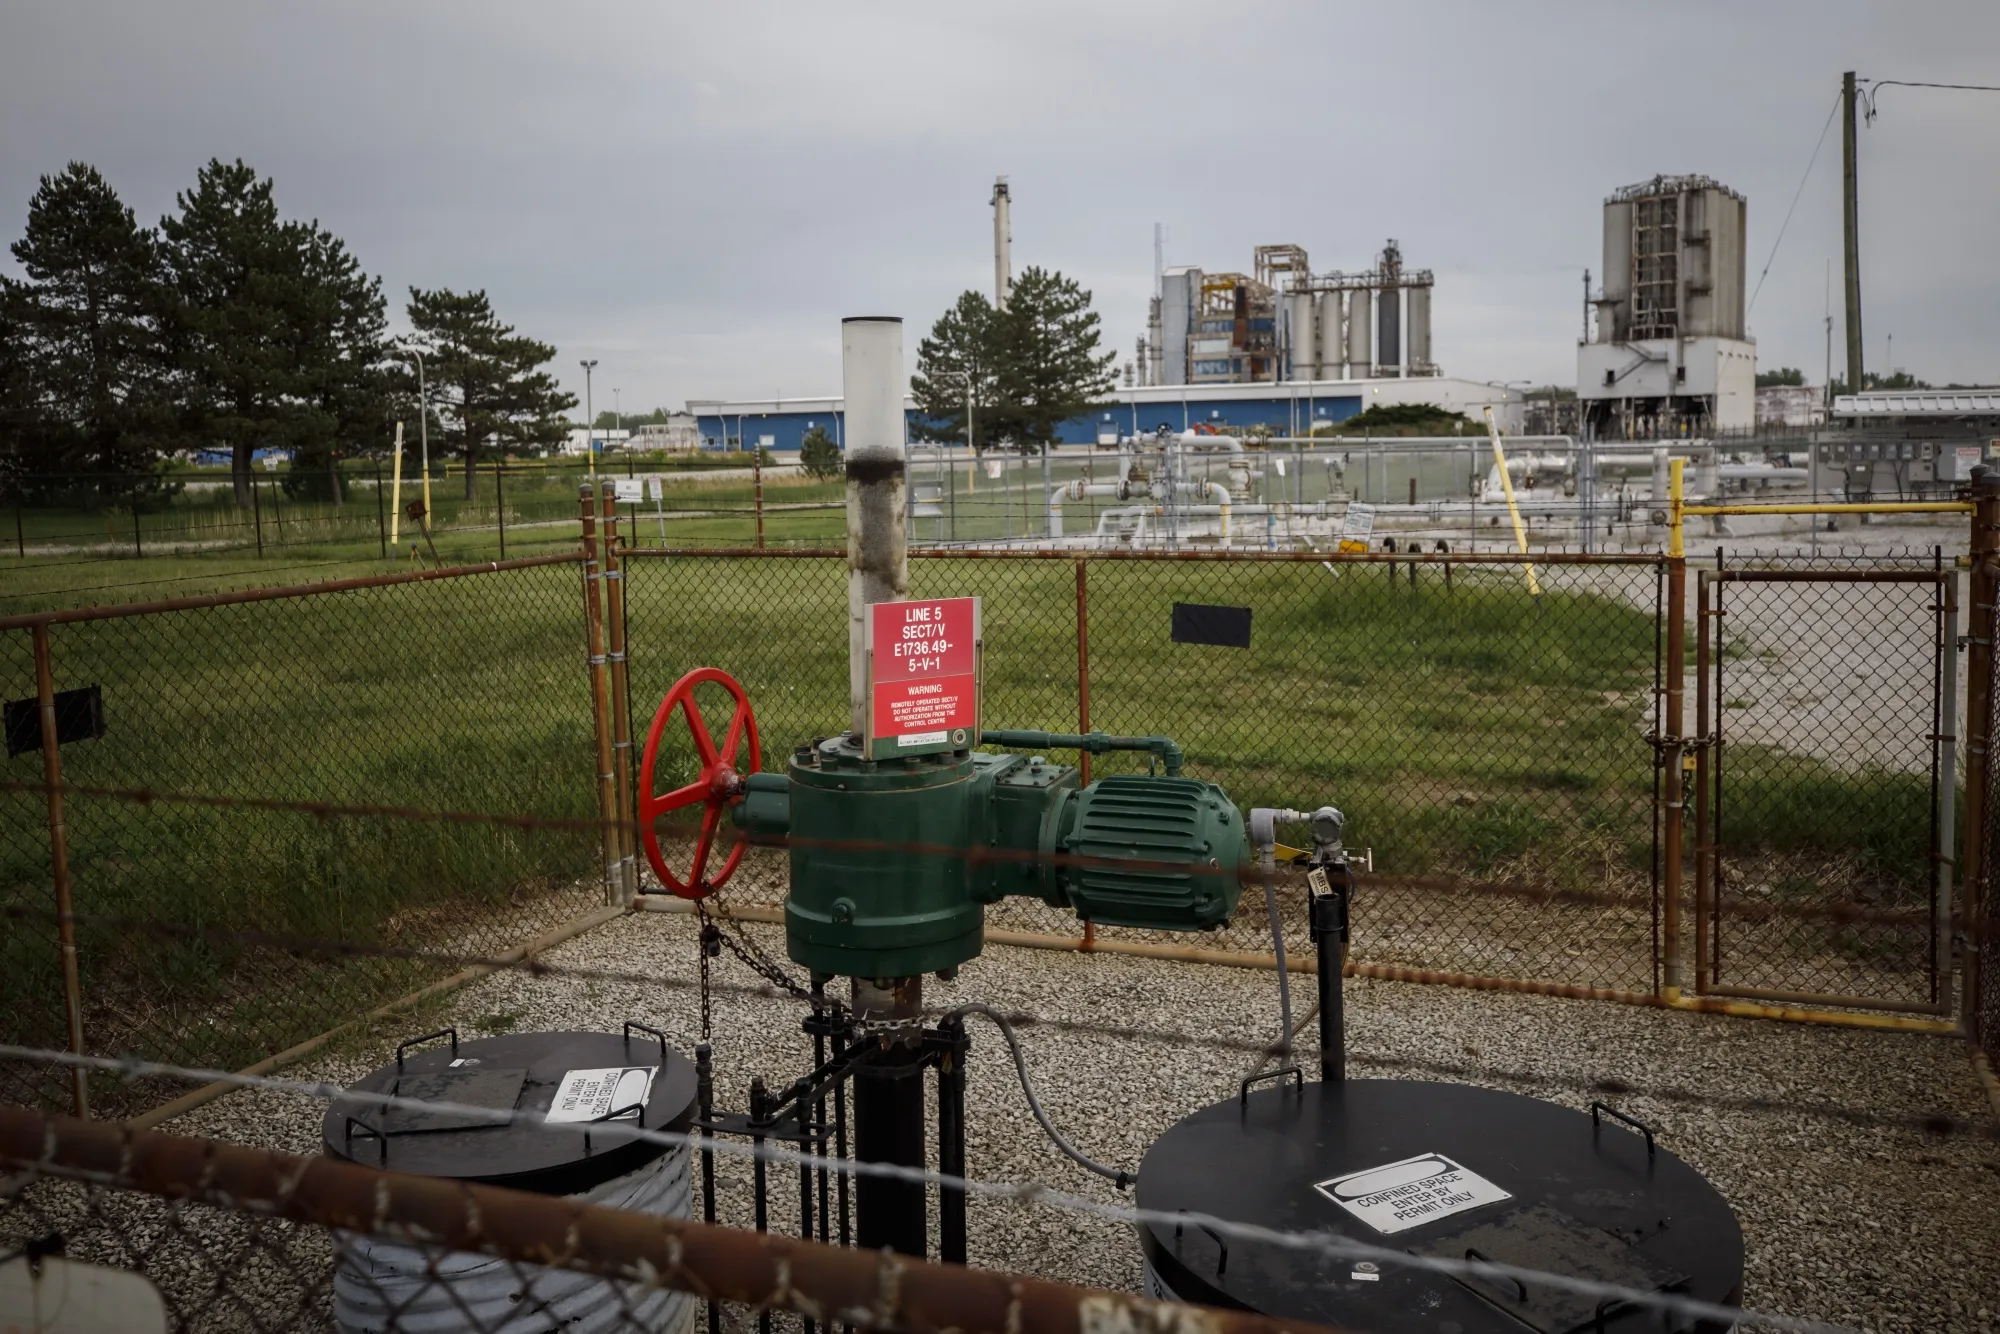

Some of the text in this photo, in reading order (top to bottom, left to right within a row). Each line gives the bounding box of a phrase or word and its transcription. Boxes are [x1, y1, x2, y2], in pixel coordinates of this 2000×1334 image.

[905, 606, 942, 623] LINE 5
[902, 623, 946, 640] SECT/V
[894, 639, 954, 657] E1736.49-
[908, 657, 941, 672] 5-V-1
[907, 684, 943, 696] WARNING
[891, 700, 916, 709] REMOTELY
[916, 697, 941, 706] OPERATED
[912, 705, 934, 713] OPERATE
[934, 703, 956, 711] WITHOUT
[894, 713, 932, 722] AUTHORIZATION
[904, 717, 946, 728] CONTROL CENTRE
[1315, 871, 1329, 894] MBS
[561, 1078, 587, 1111] PERMIT ONLY
[579, 1081, 600, 1106] ENTER BY
[591, 1072, 619, 1115] CONFINED SPACE
[1357, 1172, 1463, 1208] CONFINED SPACE
[1391, 1186, 1453, 1210] ENTER BY
[1393, 1191, 1475, 1221] PERMIT ONLY
